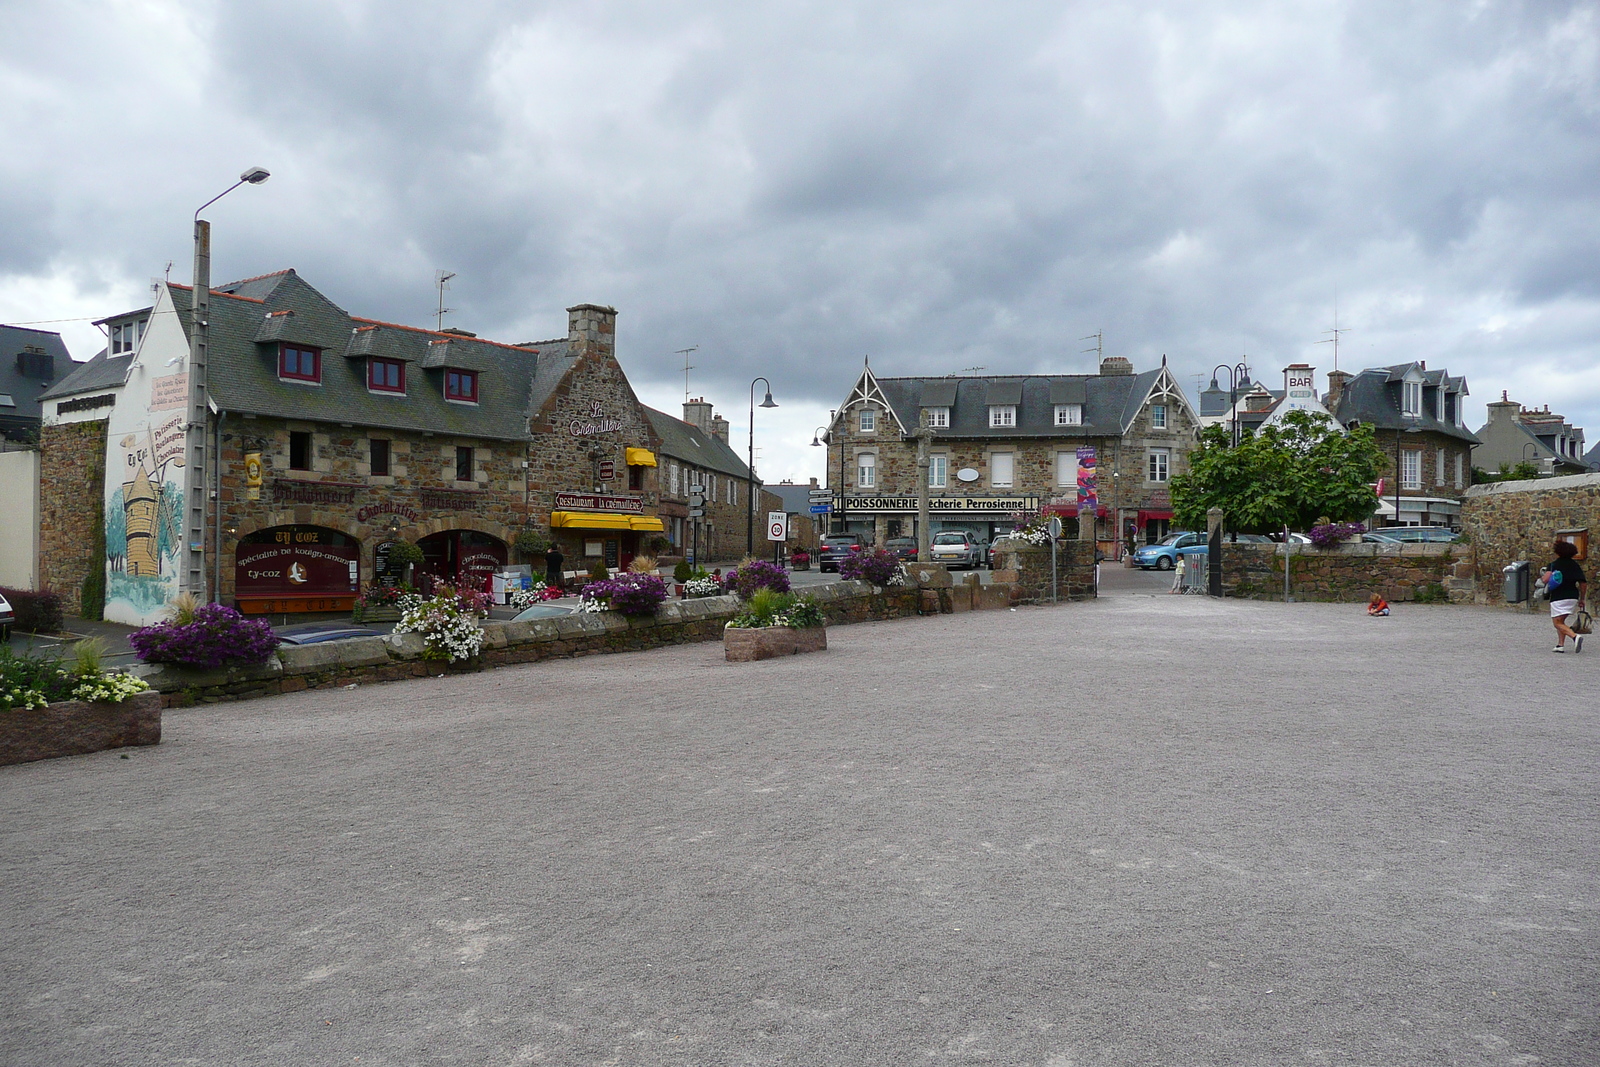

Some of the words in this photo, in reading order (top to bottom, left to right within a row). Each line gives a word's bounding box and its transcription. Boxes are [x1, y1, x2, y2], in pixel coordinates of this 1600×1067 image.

[1289, 377, 1311, 387] BAR
[590, 401, 604, 418] La
[156, 444, 185, 464] Chocolatier
[357, 500, 418, 523] Chocolatier
[846, 498, 918, 508] POISSONNERIE
[928, 499, 962, 509] êcherie
[966, 499, 1024, 509] Perrosienne
[295, 547, 350, 566] kouign-aman
